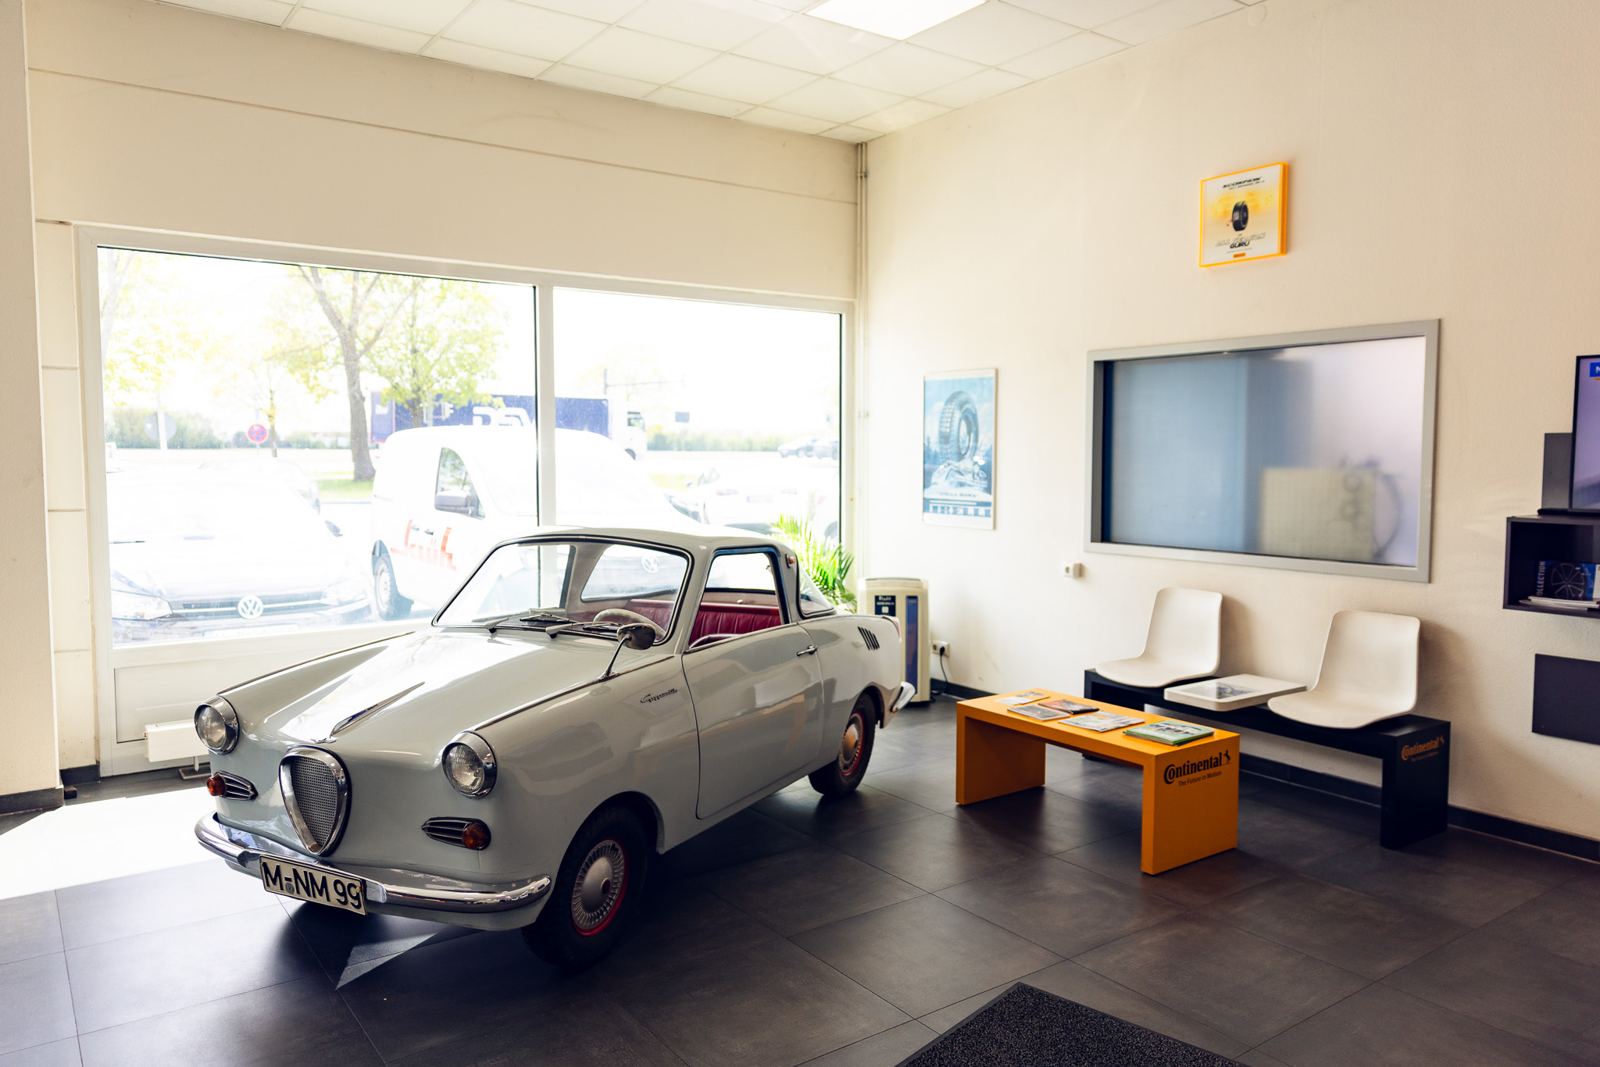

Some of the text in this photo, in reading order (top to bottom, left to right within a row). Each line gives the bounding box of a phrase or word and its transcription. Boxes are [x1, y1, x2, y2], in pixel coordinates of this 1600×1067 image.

[1535, 560, 1546, 597] OLLECTION
[1401, 736, 1440, 761] Continental
[1163, 751, 1223, 785] Continental
[333, 878, 362, 910] 99
